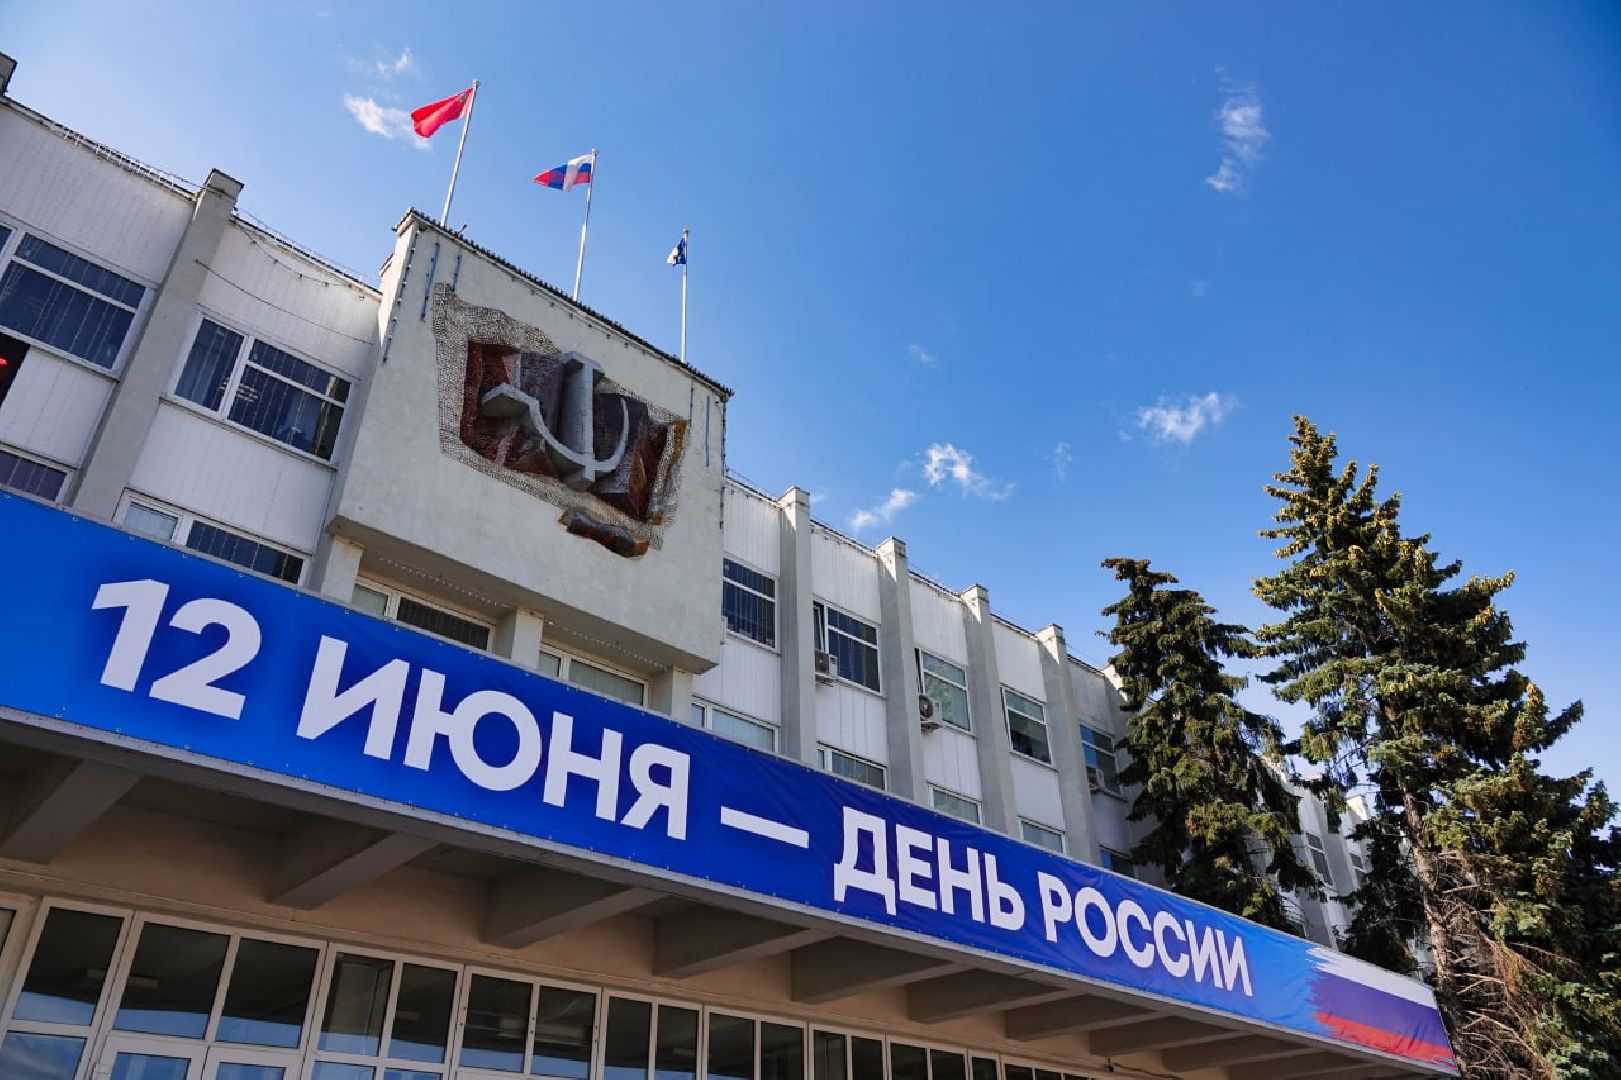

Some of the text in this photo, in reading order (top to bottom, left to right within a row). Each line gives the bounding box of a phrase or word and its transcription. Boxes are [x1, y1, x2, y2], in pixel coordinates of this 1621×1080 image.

[92, 578, 261, 720] 12
[296, 635, 691, 841] ИЮНЯ
[833, 806, 1025, 931] ДЕНЬ
[1038, 871, 1254, 997] РОССИИ
